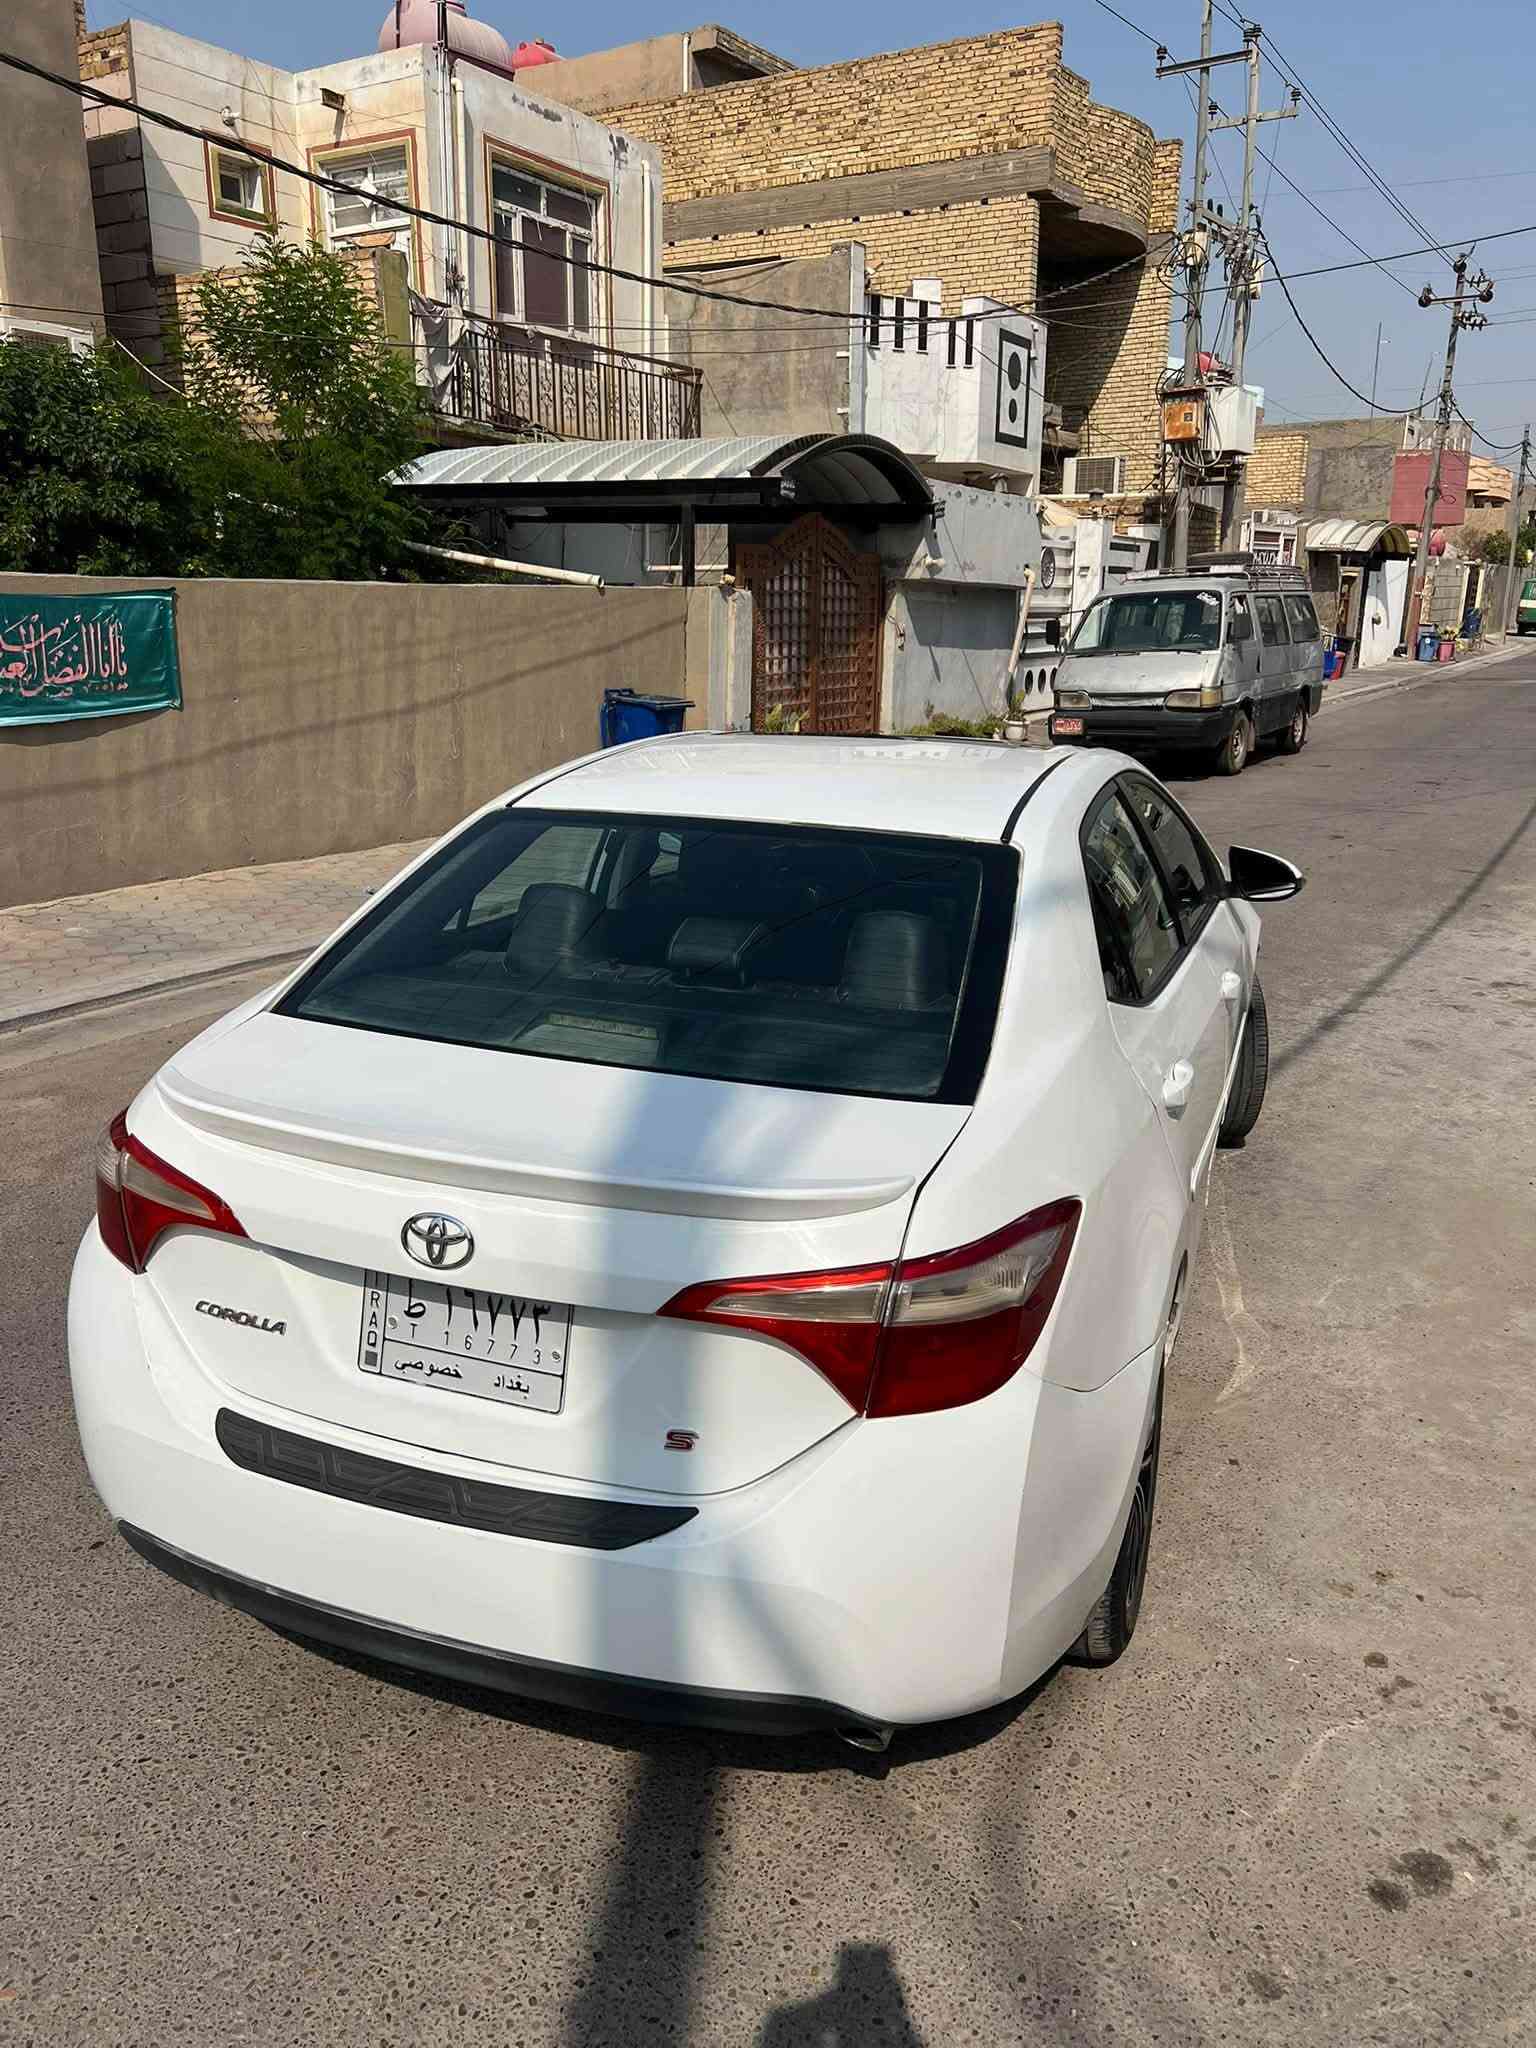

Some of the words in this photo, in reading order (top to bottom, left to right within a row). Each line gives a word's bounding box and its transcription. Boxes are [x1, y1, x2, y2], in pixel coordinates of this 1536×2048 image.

[40, 620, 97, 686] الفضل
[194, 1299, 287, 1336] COROLLA
[443, 1330, 543, 1365] 16773
[394, 1358, 464, 1380] خصوصي
[493, 1374, 531, 1400] بغداد
[664, 1428, 700, 1453] S
